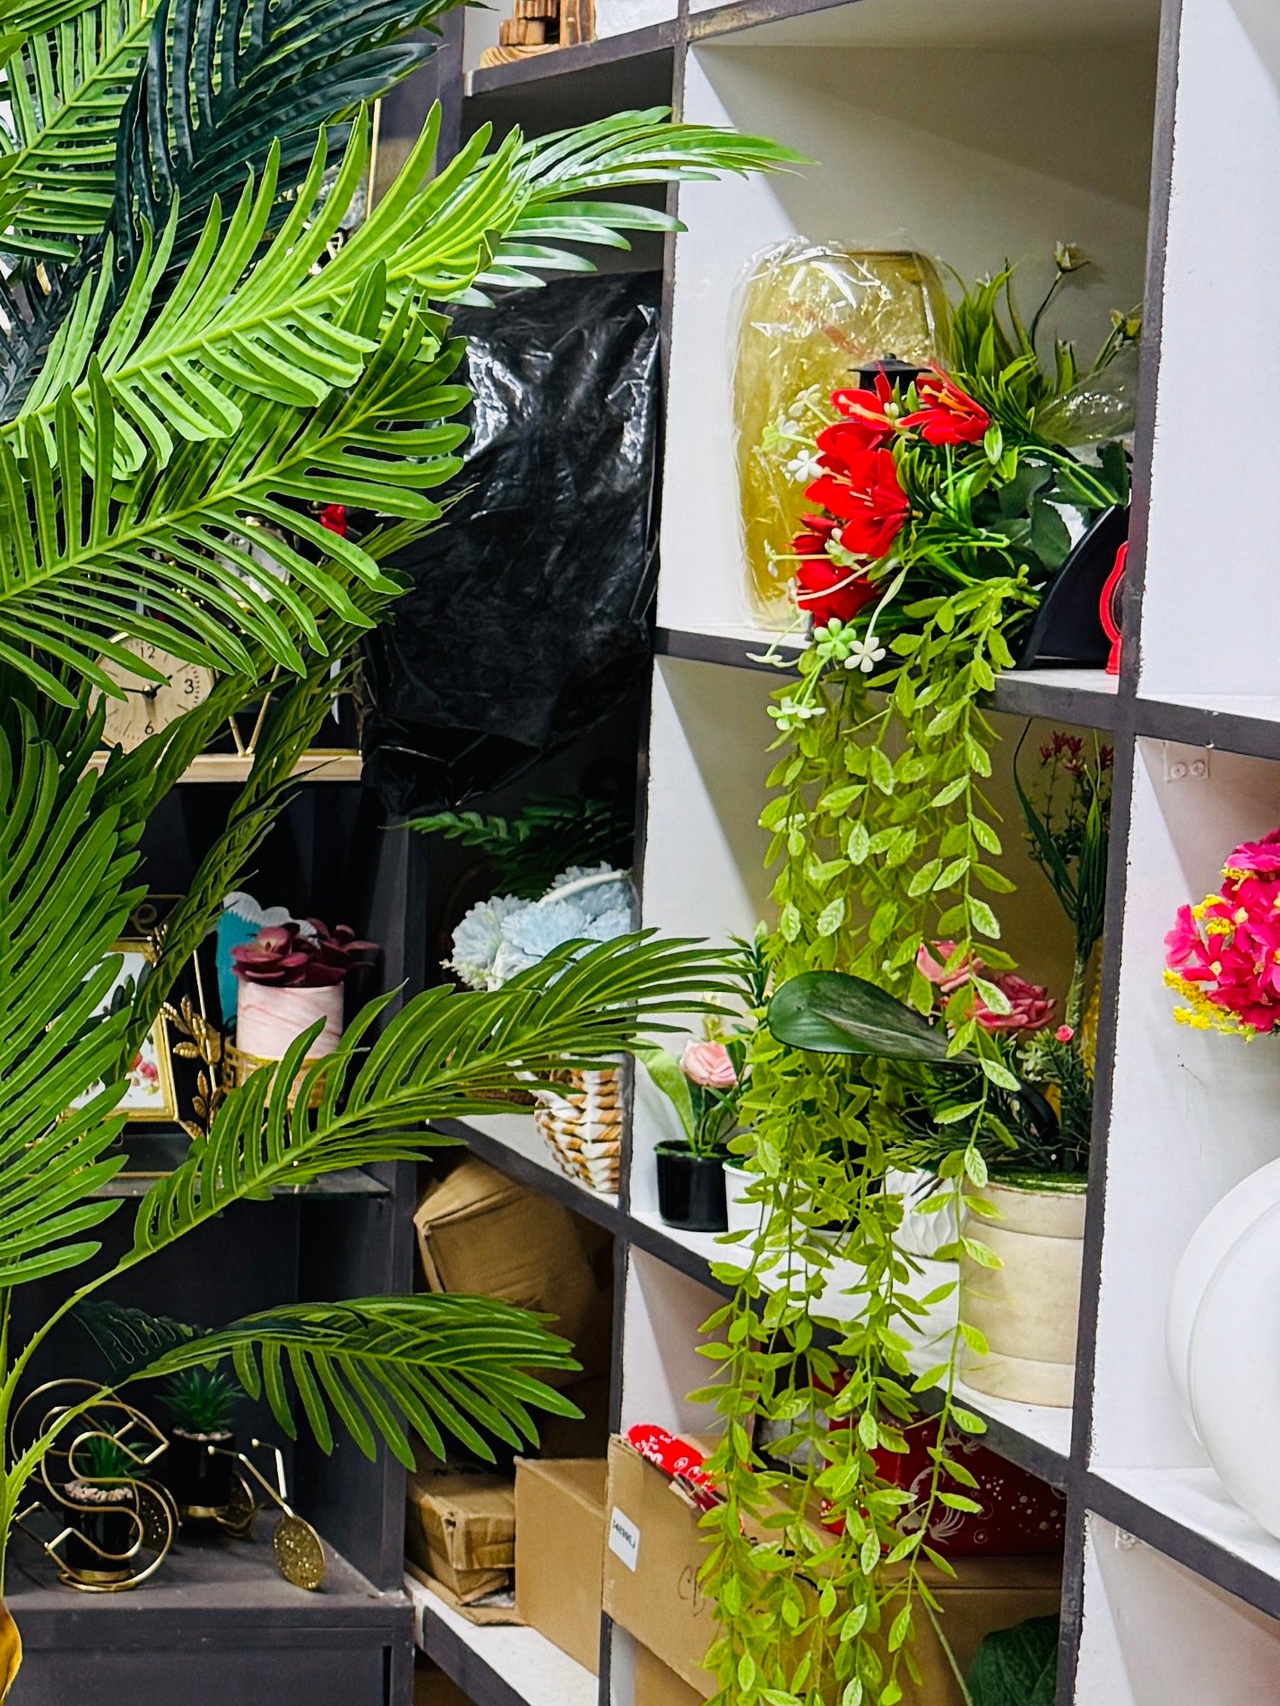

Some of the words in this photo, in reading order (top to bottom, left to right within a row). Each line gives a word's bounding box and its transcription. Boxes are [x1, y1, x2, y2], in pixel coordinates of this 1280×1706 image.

[139, 646, 156, 659] 12
[183, 678, 195, 695] 3
[144, 720, 155, 735] 6
